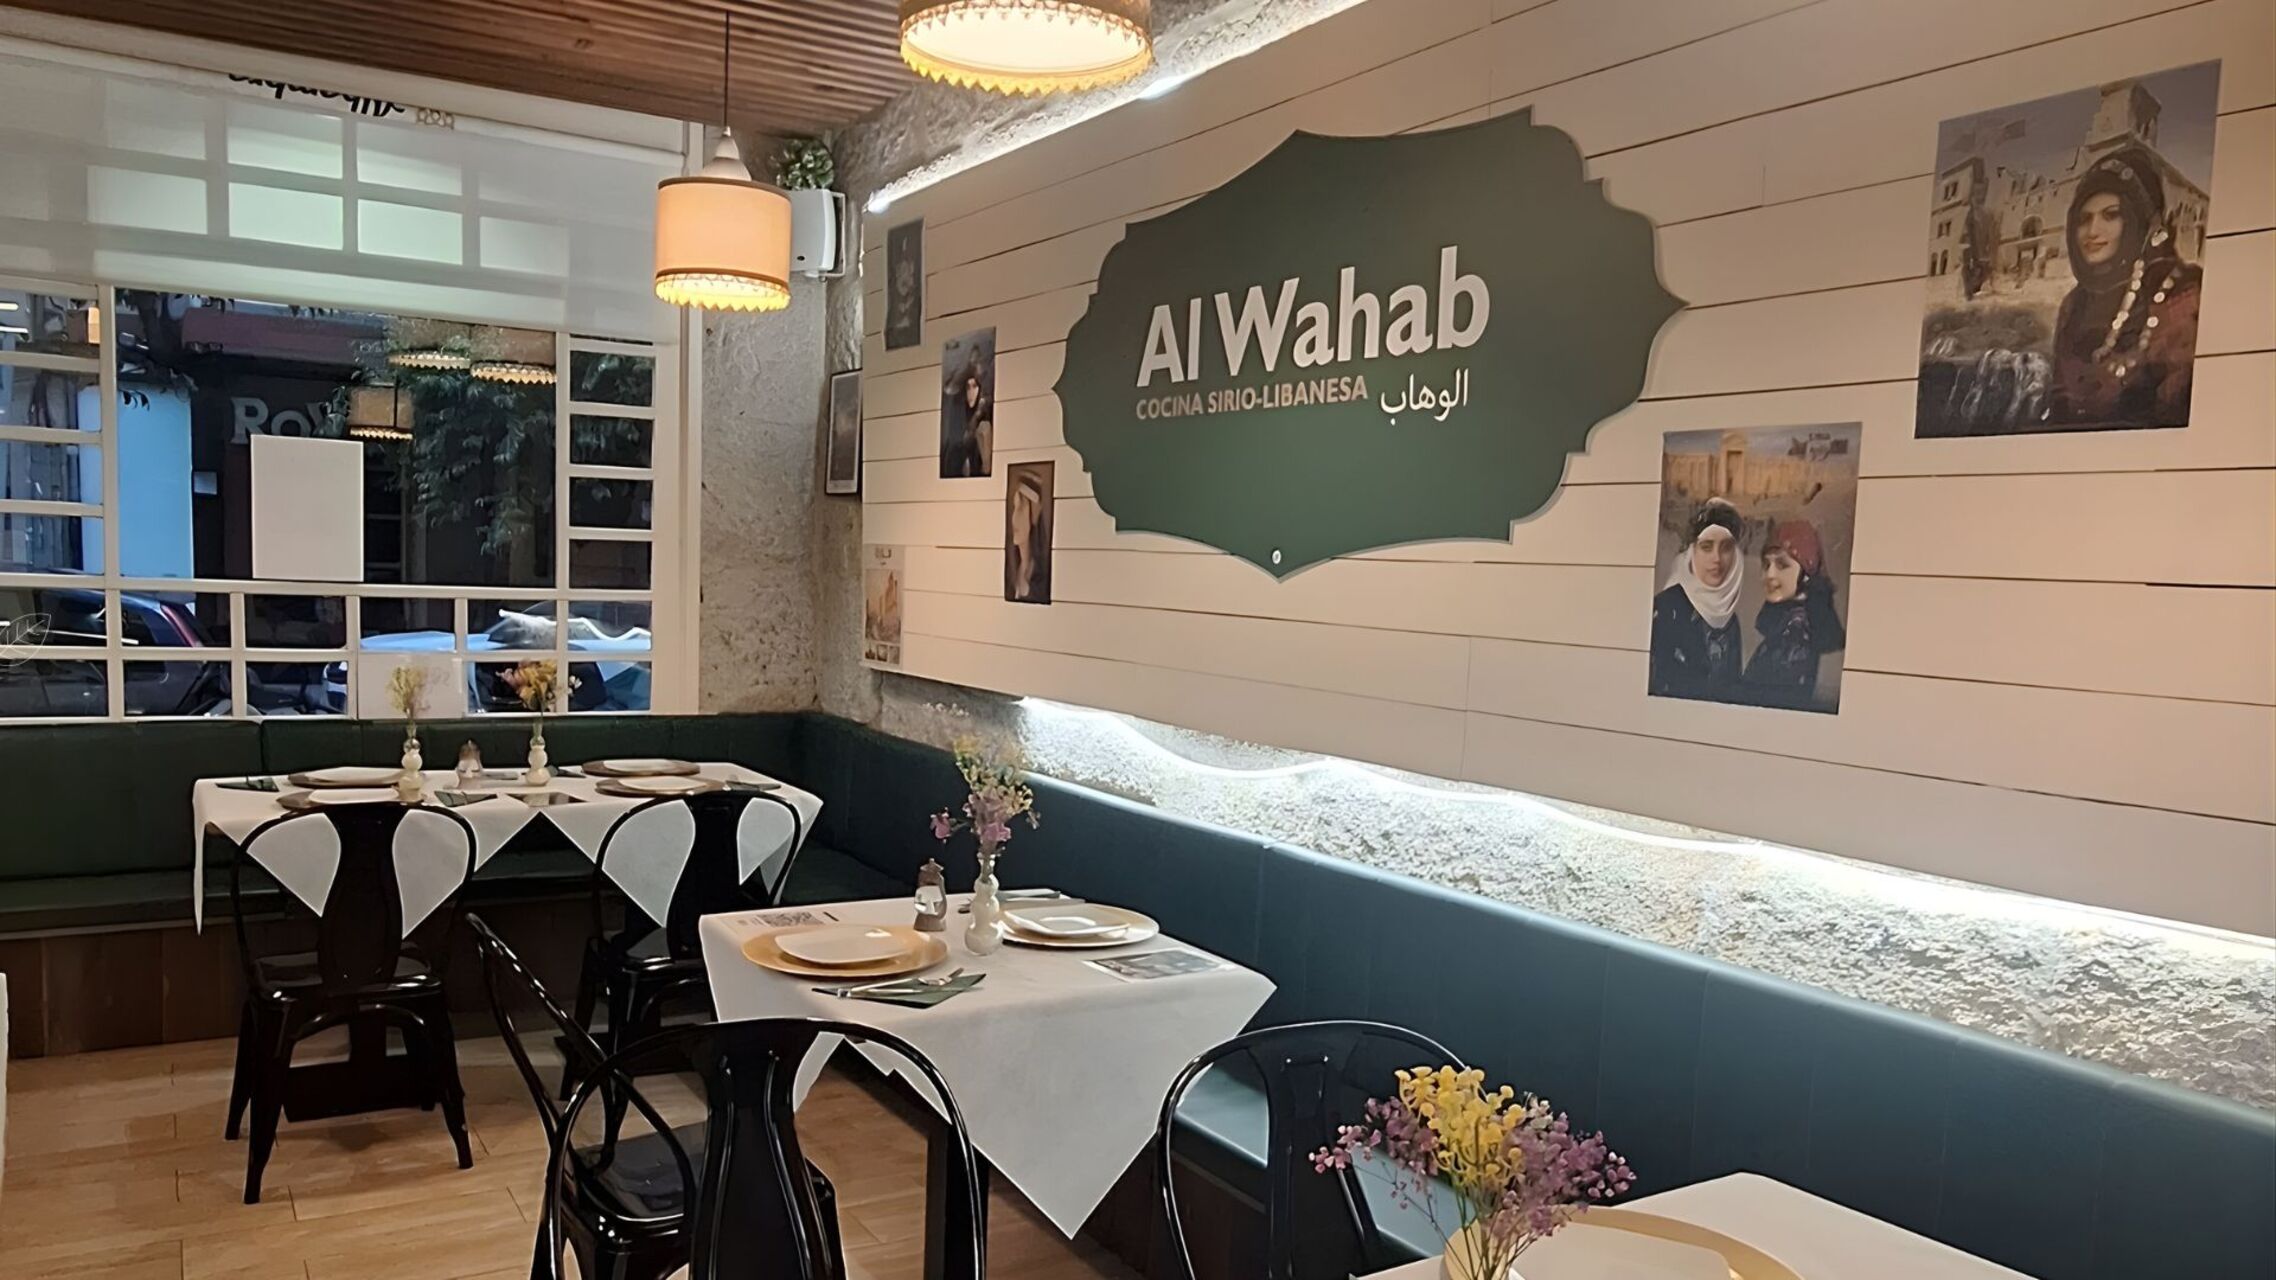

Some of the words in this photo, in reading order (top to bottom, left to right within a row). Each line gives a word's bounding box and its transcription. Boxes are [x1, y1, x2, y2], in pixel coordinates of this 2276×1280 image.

[1136, 297, 1202, 388] Al
[1214, 245, 1491, 377] Wahab
[1136, 392, 1204, 421] COCINA
[1207, 374, 1369, 415] SIRIO-LIBANESA
[1380, 368, 1470, 427] الوهاب
